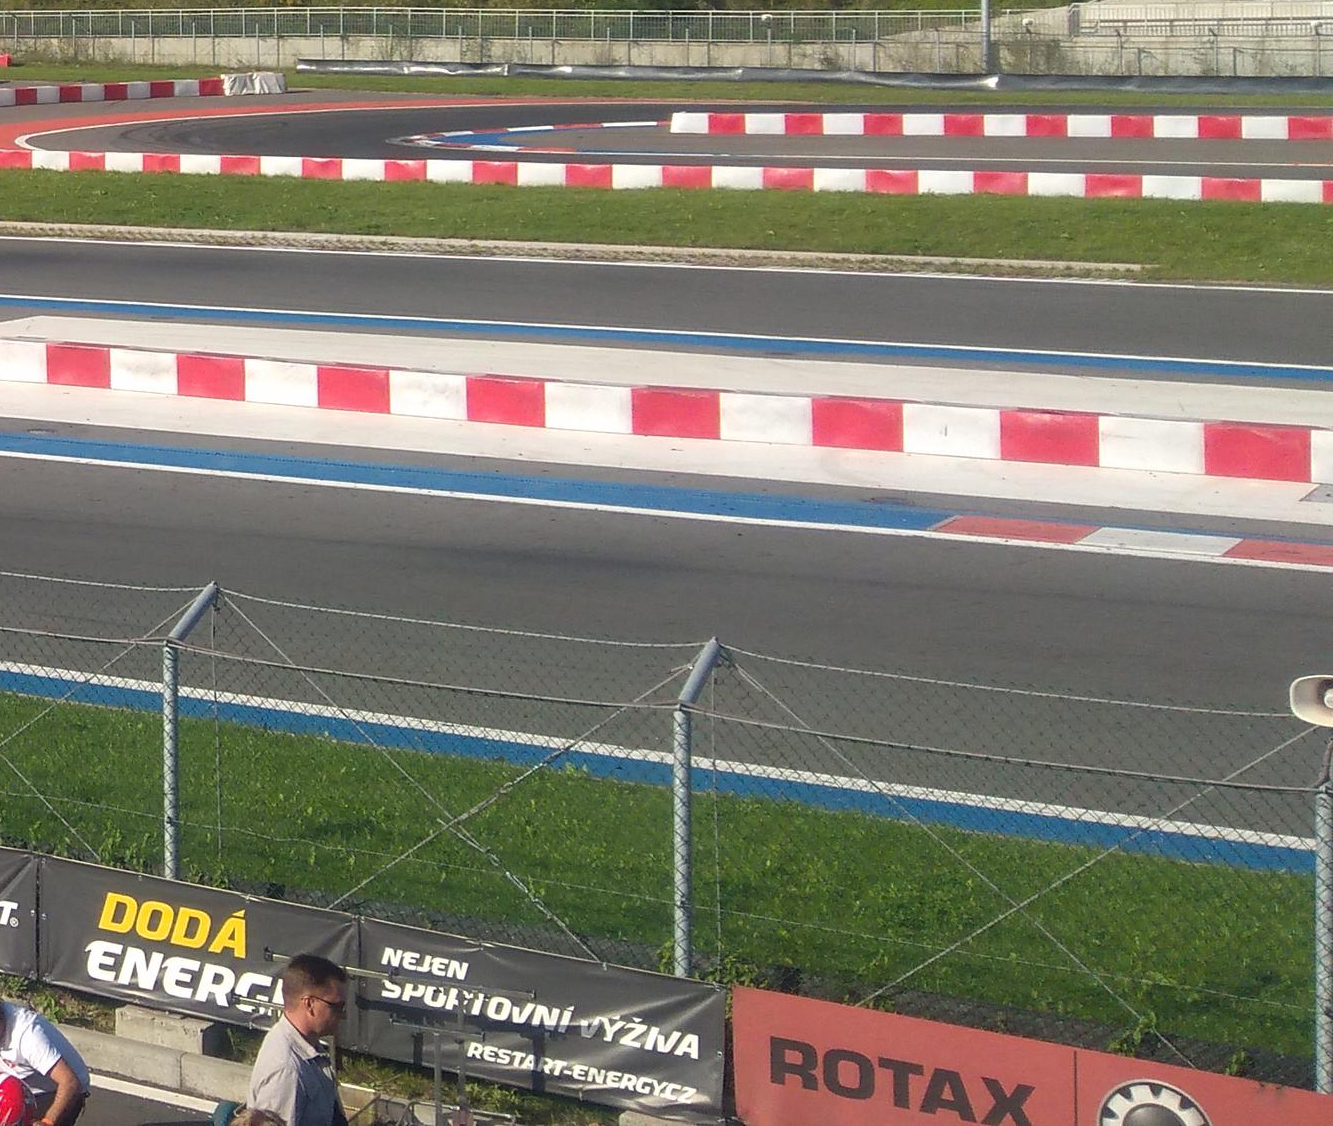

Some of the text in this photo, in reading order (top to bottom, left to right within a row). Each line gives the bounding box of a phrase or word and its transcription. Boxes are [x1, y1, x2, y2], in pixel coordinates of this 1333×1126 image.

[98, 891, 247, 958] DODÁ
[381, 946, 469, 981] NEJEN
[381, 980, 700, 1060] SPORTOVNÍ VÝŽIVA
[466, 1042, 697, 1105] RESTART-ENERGY.CZ
[769, 1036, 1035, 1126] ROTAX
